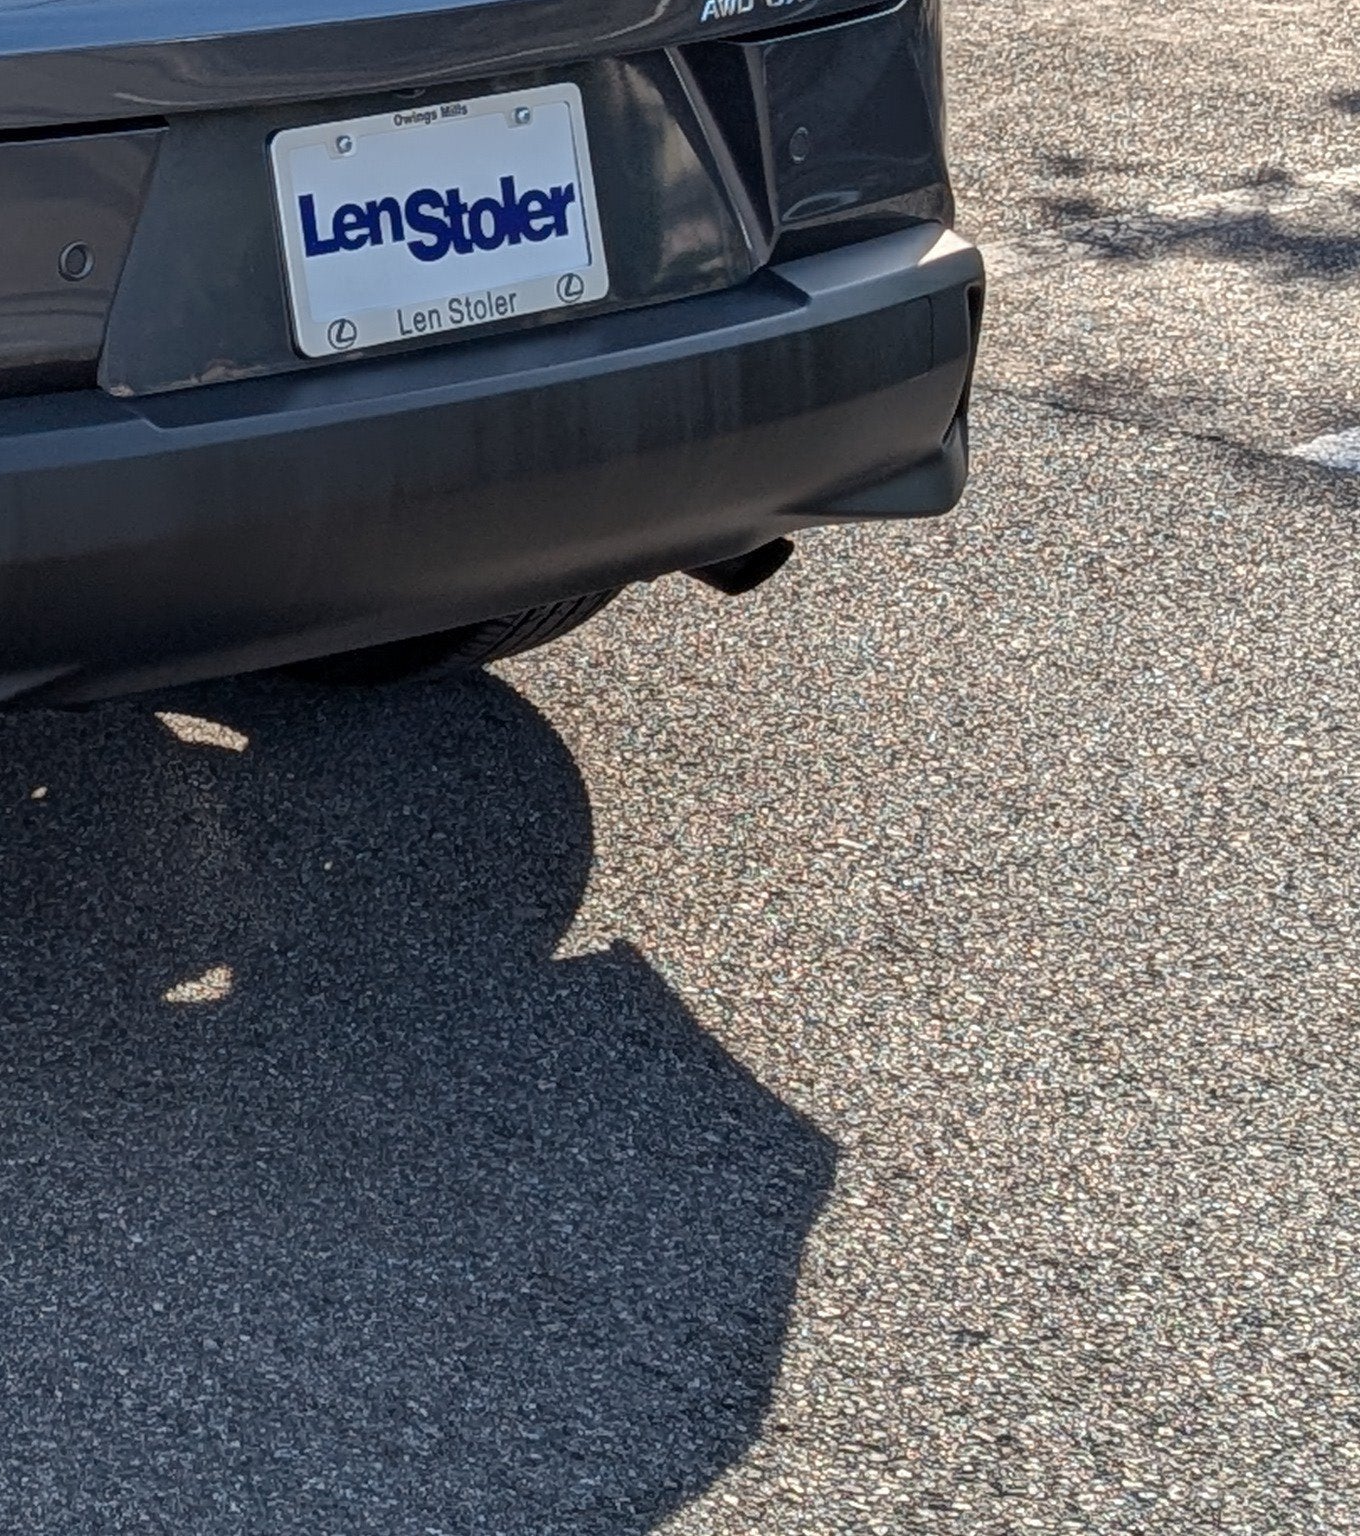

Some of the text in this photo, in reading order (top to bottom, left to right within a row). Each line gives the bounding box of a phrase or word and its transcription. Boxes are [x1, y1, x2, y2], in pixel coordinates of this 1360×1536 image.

[393, 103, 468, 126] Owings Mills
[397, 291, 518, 336] Len Stoler
